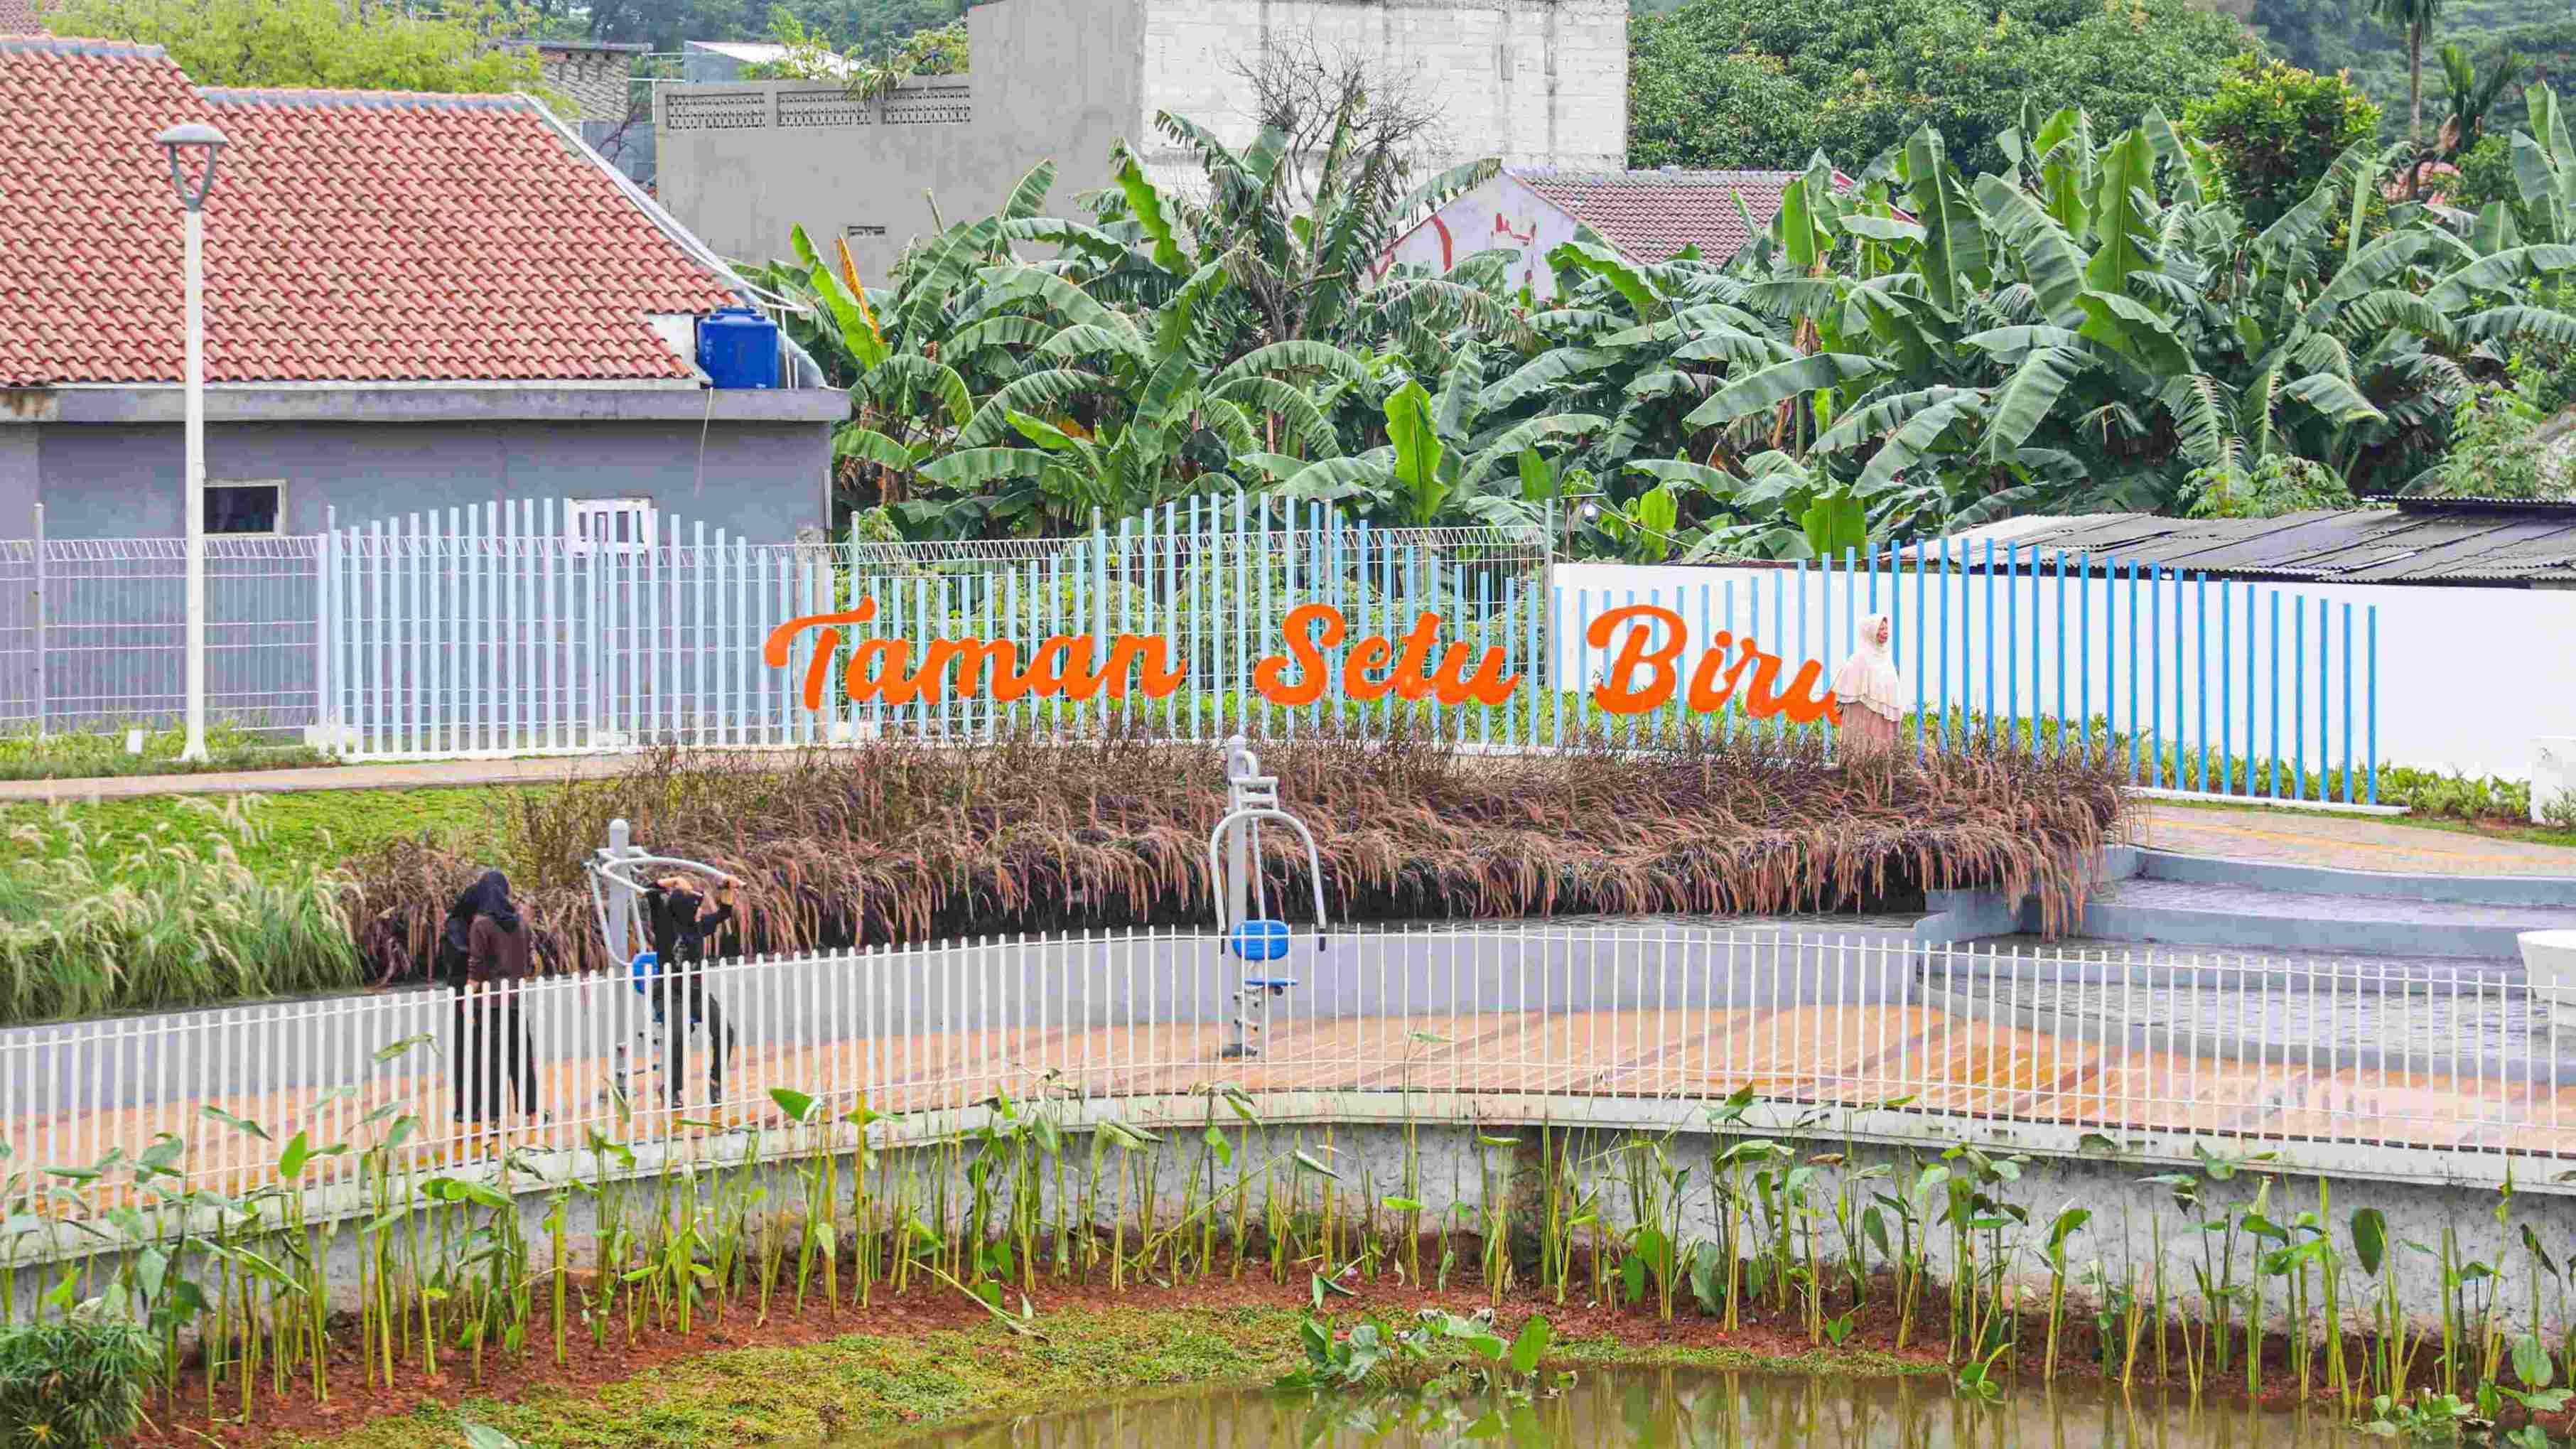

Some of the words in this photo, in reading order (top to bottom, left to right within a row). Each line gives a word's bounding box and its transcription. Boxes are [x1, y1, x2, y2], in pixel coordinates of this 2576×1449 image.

[765, 595, 1187, 711] Taman
[1254, 603, 1521, 706] Setu
[1587, 604, 1843, 726] Biru
